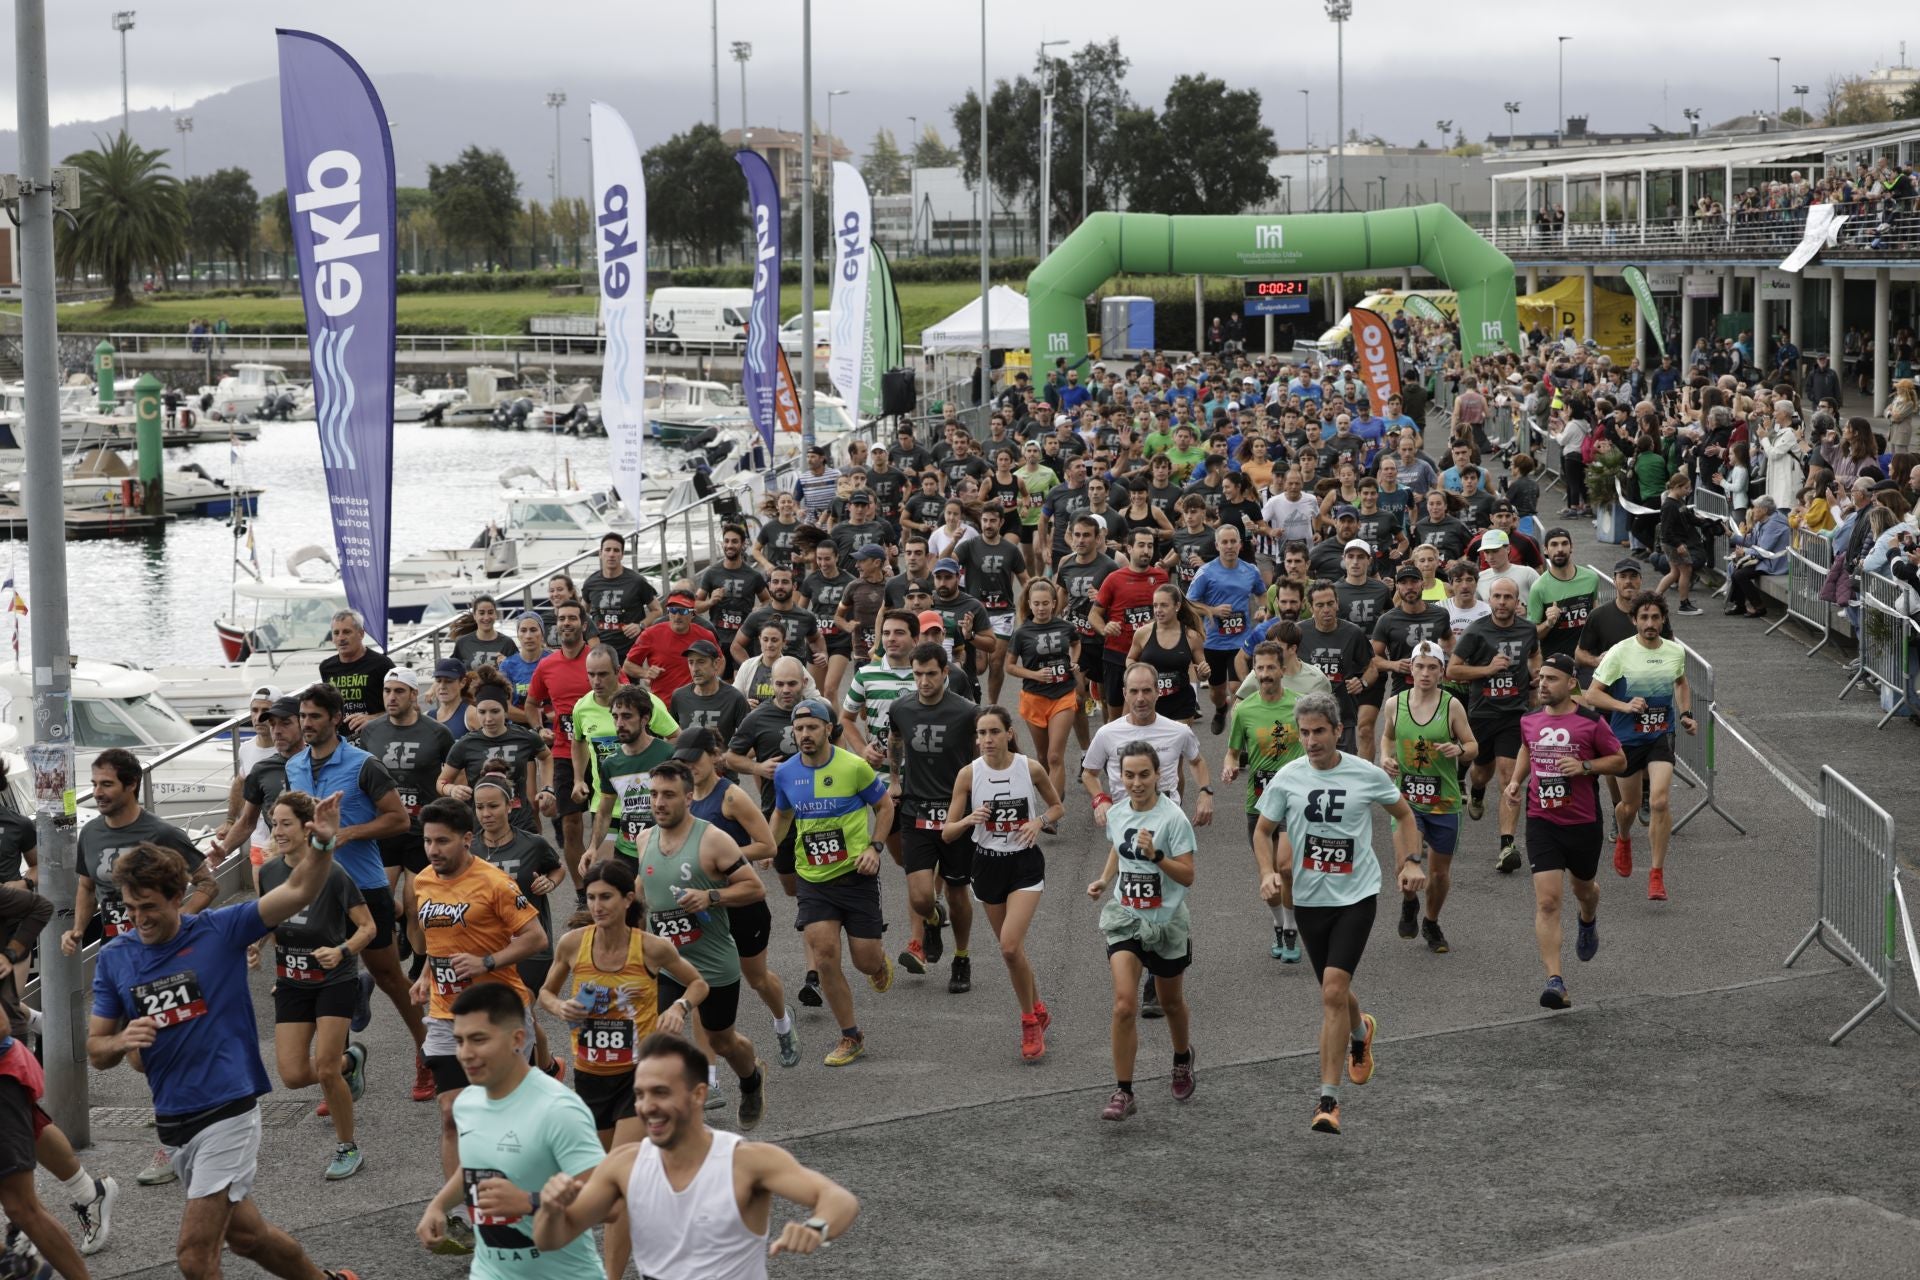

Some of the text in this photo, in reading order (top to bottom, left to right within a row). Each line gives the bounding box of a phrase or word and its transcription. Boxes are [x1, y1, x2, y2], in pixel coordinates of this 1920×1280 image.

[1258, 282, 1302, 294] 0:00:21
[139, 396, 158, 420] C
[604, 614, 618, 624] 66
[723, 613, 742, 626] 369
[1128, 612, 1151, 624] 373
[1565, 608, 1588, 621] 176
[816, 618, 834, 629] 307
[1222, 617, 1243, 628] 202
[341, 674, 369, 688] BEÑAT
[1488, 677, 1513, 690] 105
[1640, 712, 1665, 725] 356
[1539, 727, 1570, 747] 20
[1406, 782, 1436, 796] 389
[1538, 785, 1566, 799] 349
[795, 799, 837, 812] NARDÍN
[995, 808, 1018, 822] 22
[628, 822, 646, 834] 87
[809, 839, 840, 855] 338
[1310, 846, 1347, 863] 279
[680, 862, 692, 881] S
[1124, 882, 1155, 899] 113
[657, 918, 691, 937] 233
[285, 955, 308, 971] 95
[143, 985, 190, 1016] 221
[583, 1030, 624, 1049] 188
